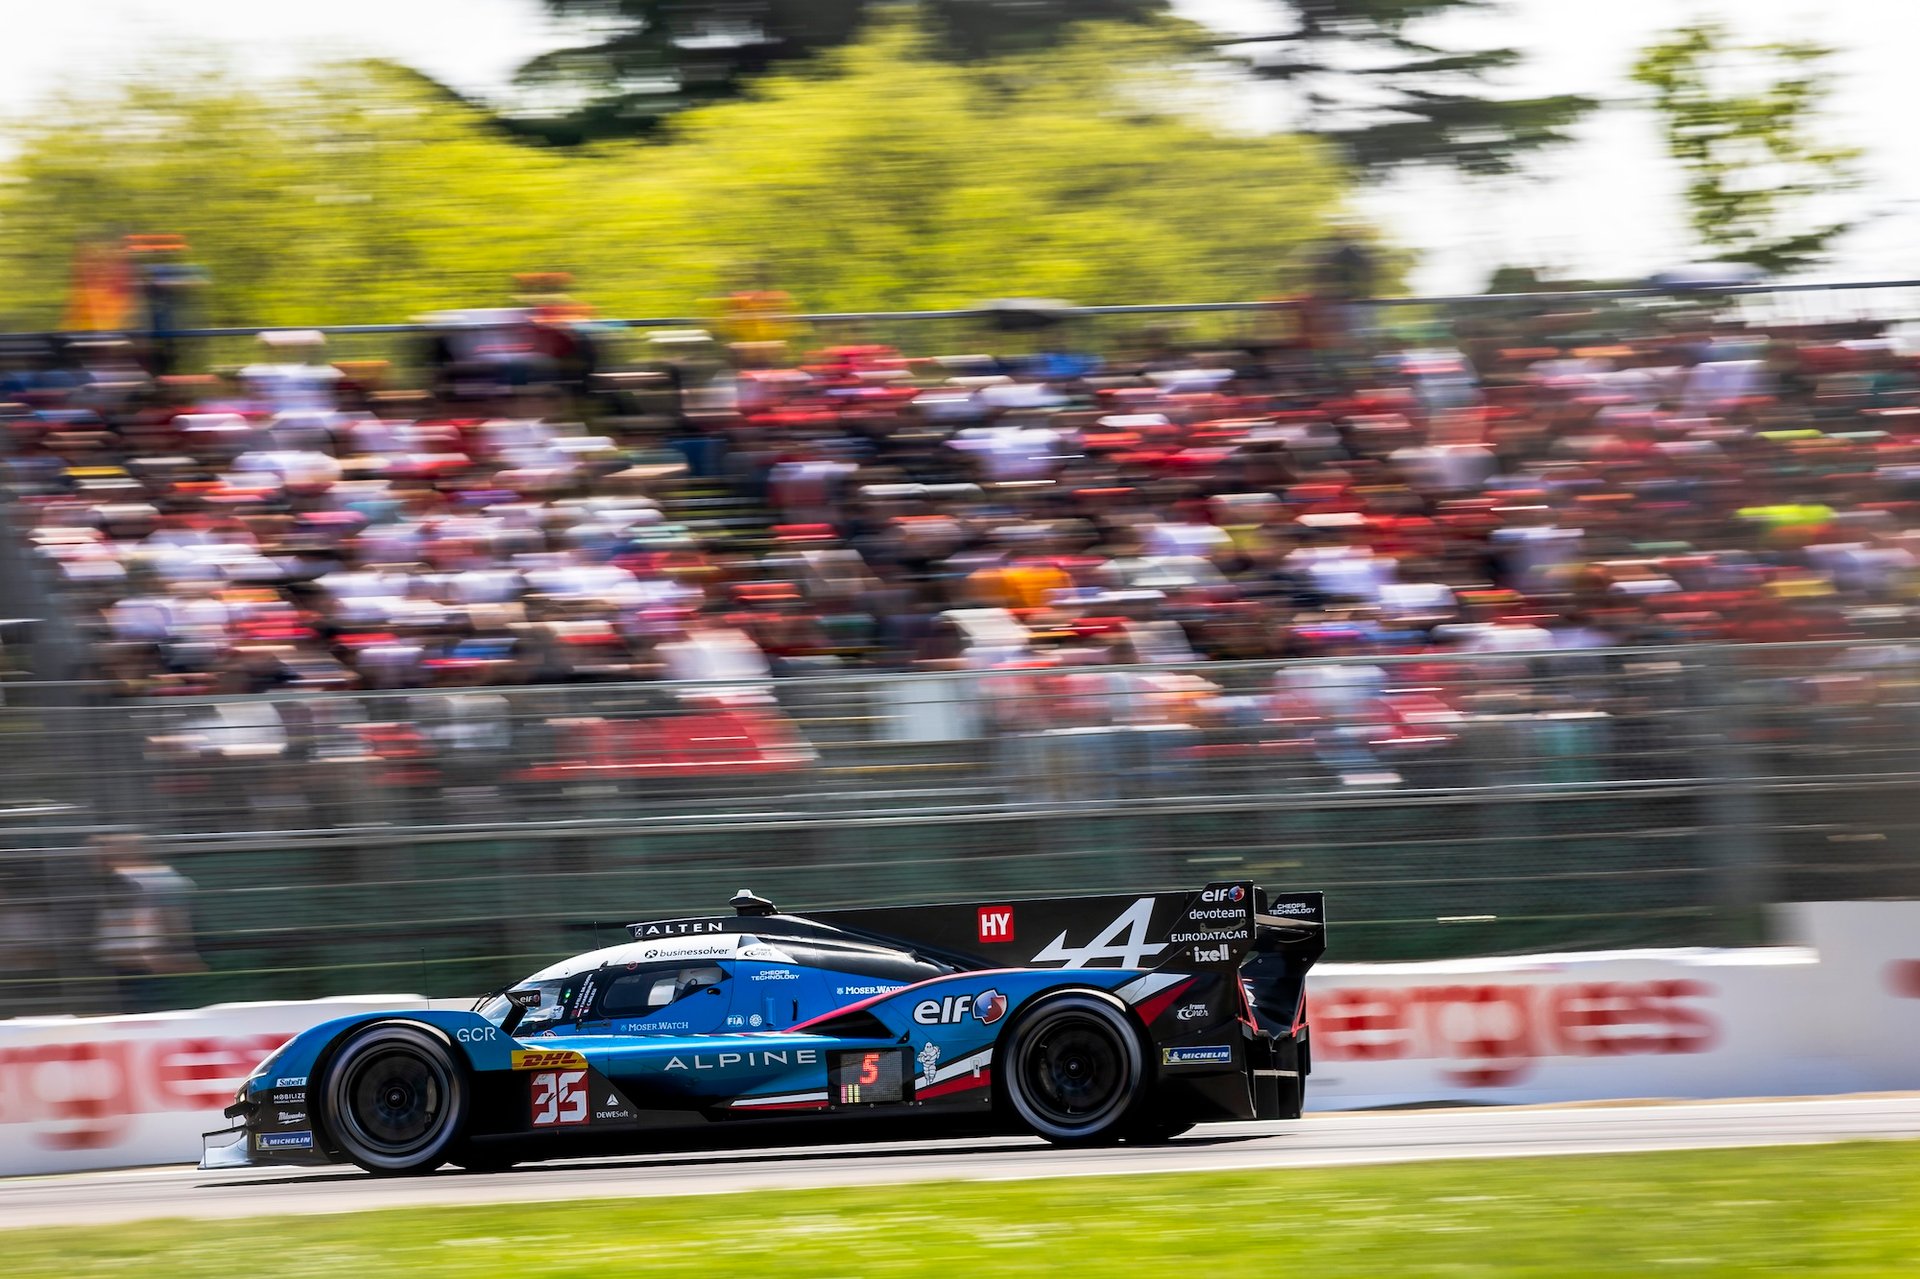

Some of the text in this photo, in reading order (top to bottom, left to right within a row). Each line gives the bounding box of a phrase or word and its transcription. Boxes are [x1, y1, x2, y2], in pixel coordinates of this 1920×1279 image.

[1201, 888, 1229, 902] elf
[1188, 908, 1246, 920] devoteam
[646, 922, 723, 935] ALTEN
[981, 913, 1010, 937] HY
[1170, 930, 1249, 943] EURODATACAR
[659, 946, 730, 958] businessolver
[1193, 943, 1230, 963] ixell
[519, 995, 533, 1003] elf
[913, 995, 972, 1025] elf
[456, 1026, 497, 1043] GCR
[521, 1051, 578, 1067] DHL
[664, 1050, 818, 1071] ALPINE
[1181, 1051, 1229, 1060] MICHELIN
[859, 1053, 881, 1085] 5
[532, 1071, 588, 1124] 35
[269, 1137, 311, 1145] MICHELIN
